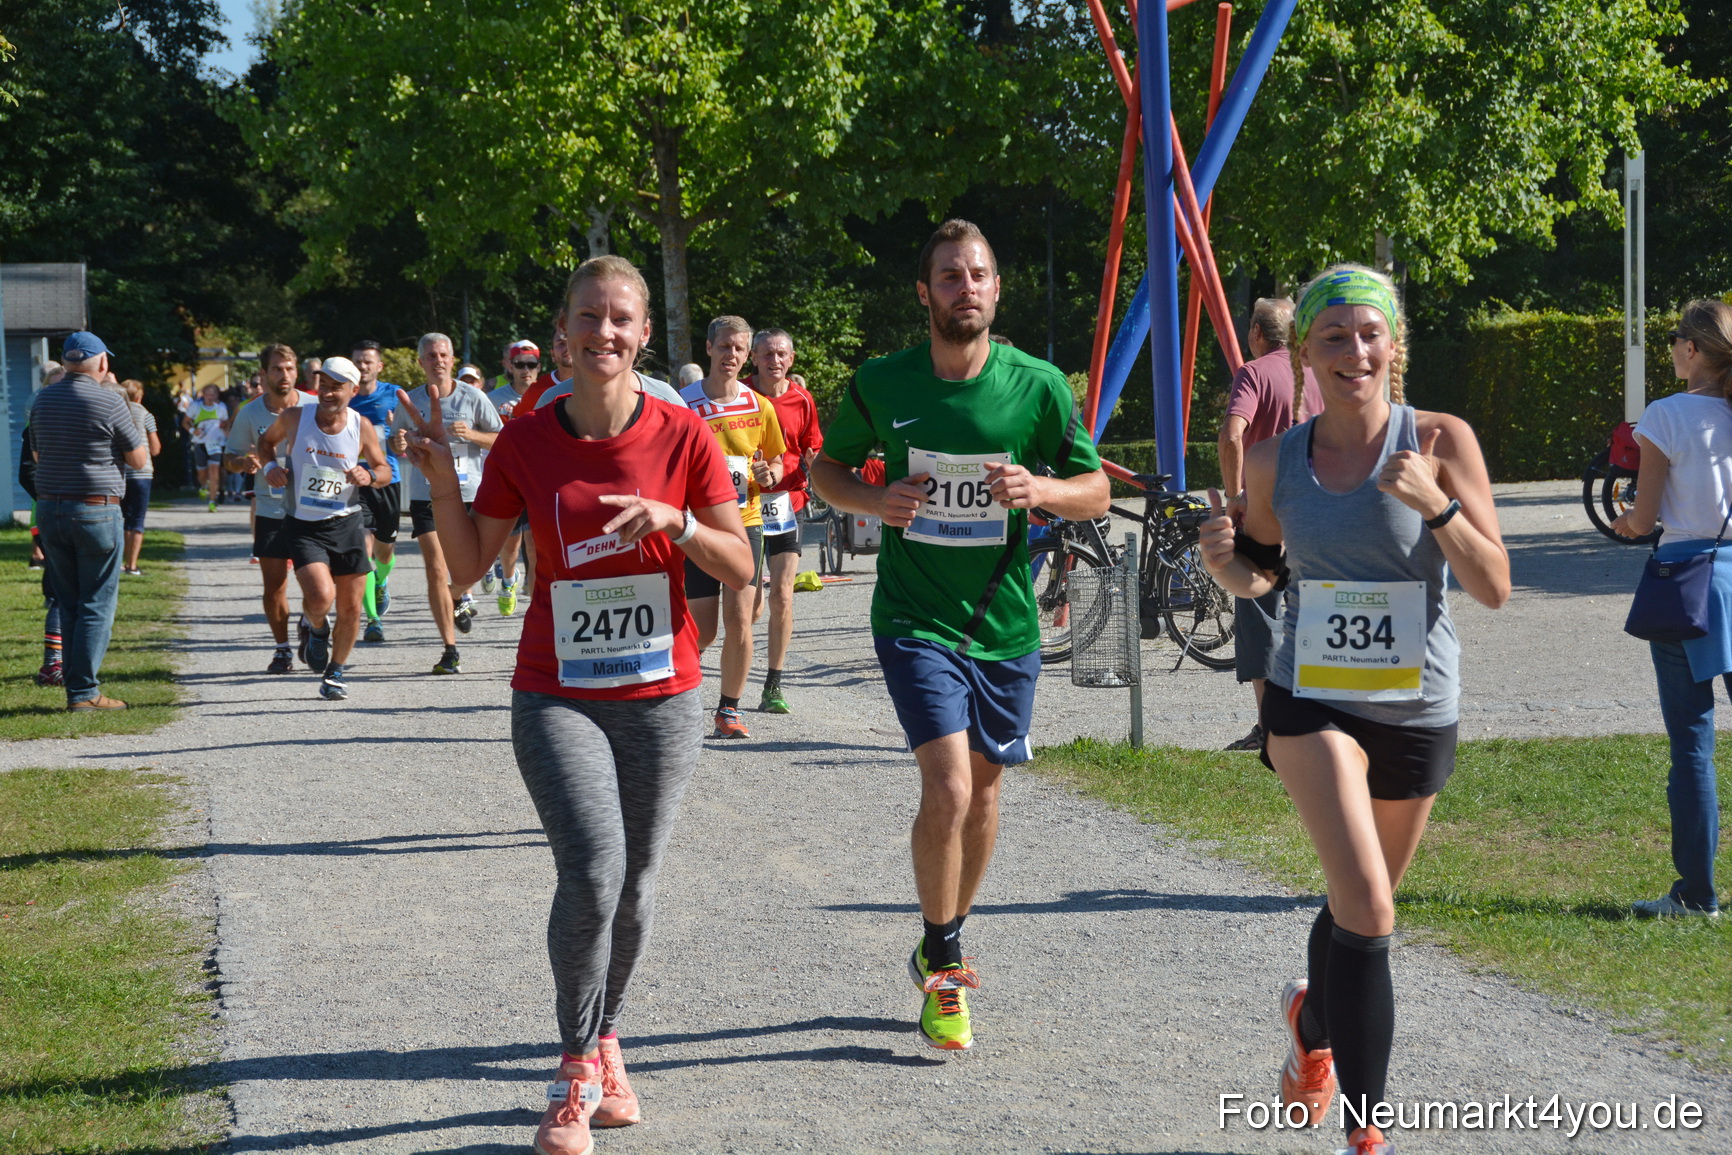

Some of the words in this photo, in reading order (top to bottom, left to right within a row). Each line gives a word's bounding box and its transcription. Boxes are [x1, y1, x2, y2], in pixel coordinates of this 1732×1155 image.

[728, 417, 762, 430] BÖGL
[937, 461, 980, 474] BOCK
[307, 477, 342, 495] 2276
[923, 477, 993, 508] 2105
[926, 509, 947, 518] PARTL
[938, 523, 972, 536] Manu
[587, 539, 616, 555] DEHN
[585, 585, 635, 601] BOCK
[1335, 591, 1388, 605] BOCK
[572, 604, 654, 643] 2470
[1326, 614, 1395, 650] 334
[607, 644, 640, 653] Neumarkt
[1322, 654, 1348, 663] PARTL
[593, 660, 641, 676] Marina
